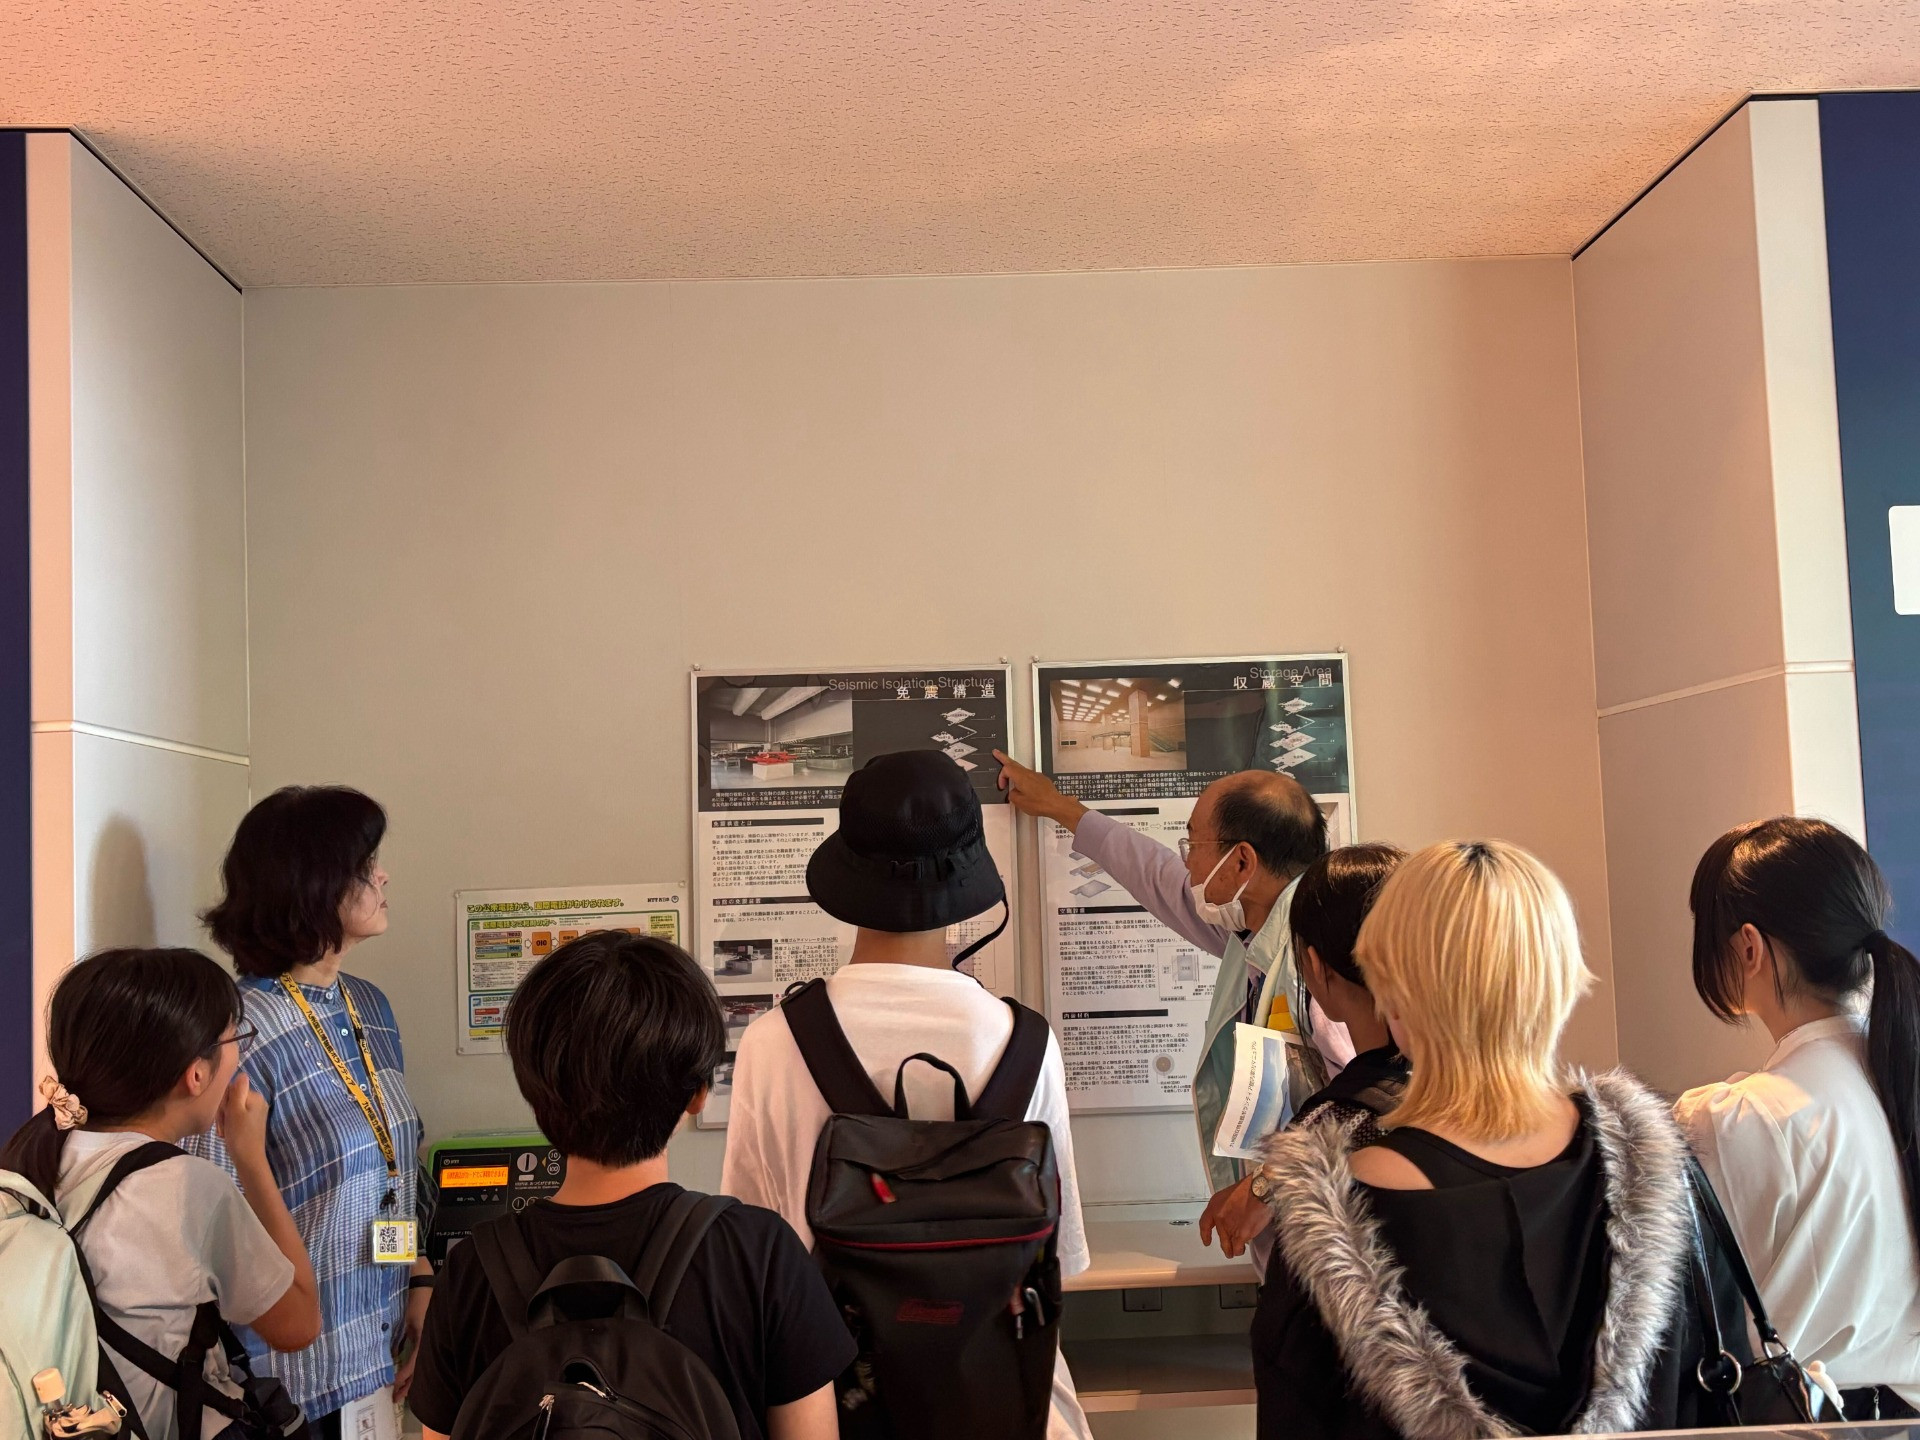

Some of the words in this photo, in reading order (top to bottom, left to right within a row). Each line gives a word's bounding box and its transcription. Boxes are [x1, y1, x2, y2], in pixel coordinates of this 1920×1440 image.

[1232, 672, 1333, 691] 収蔵空間
[1249, 665, 1299, 682] Storage
[1302, 665, 1332, 678] Area
[828, 678, 878, 692] Seismic
[882, 677, 934, 690] Isolation
[938, 675, 995, 689] Structure
[896, 683, 996, 701] 免震構造
[536, 939, 548, 947] 010
